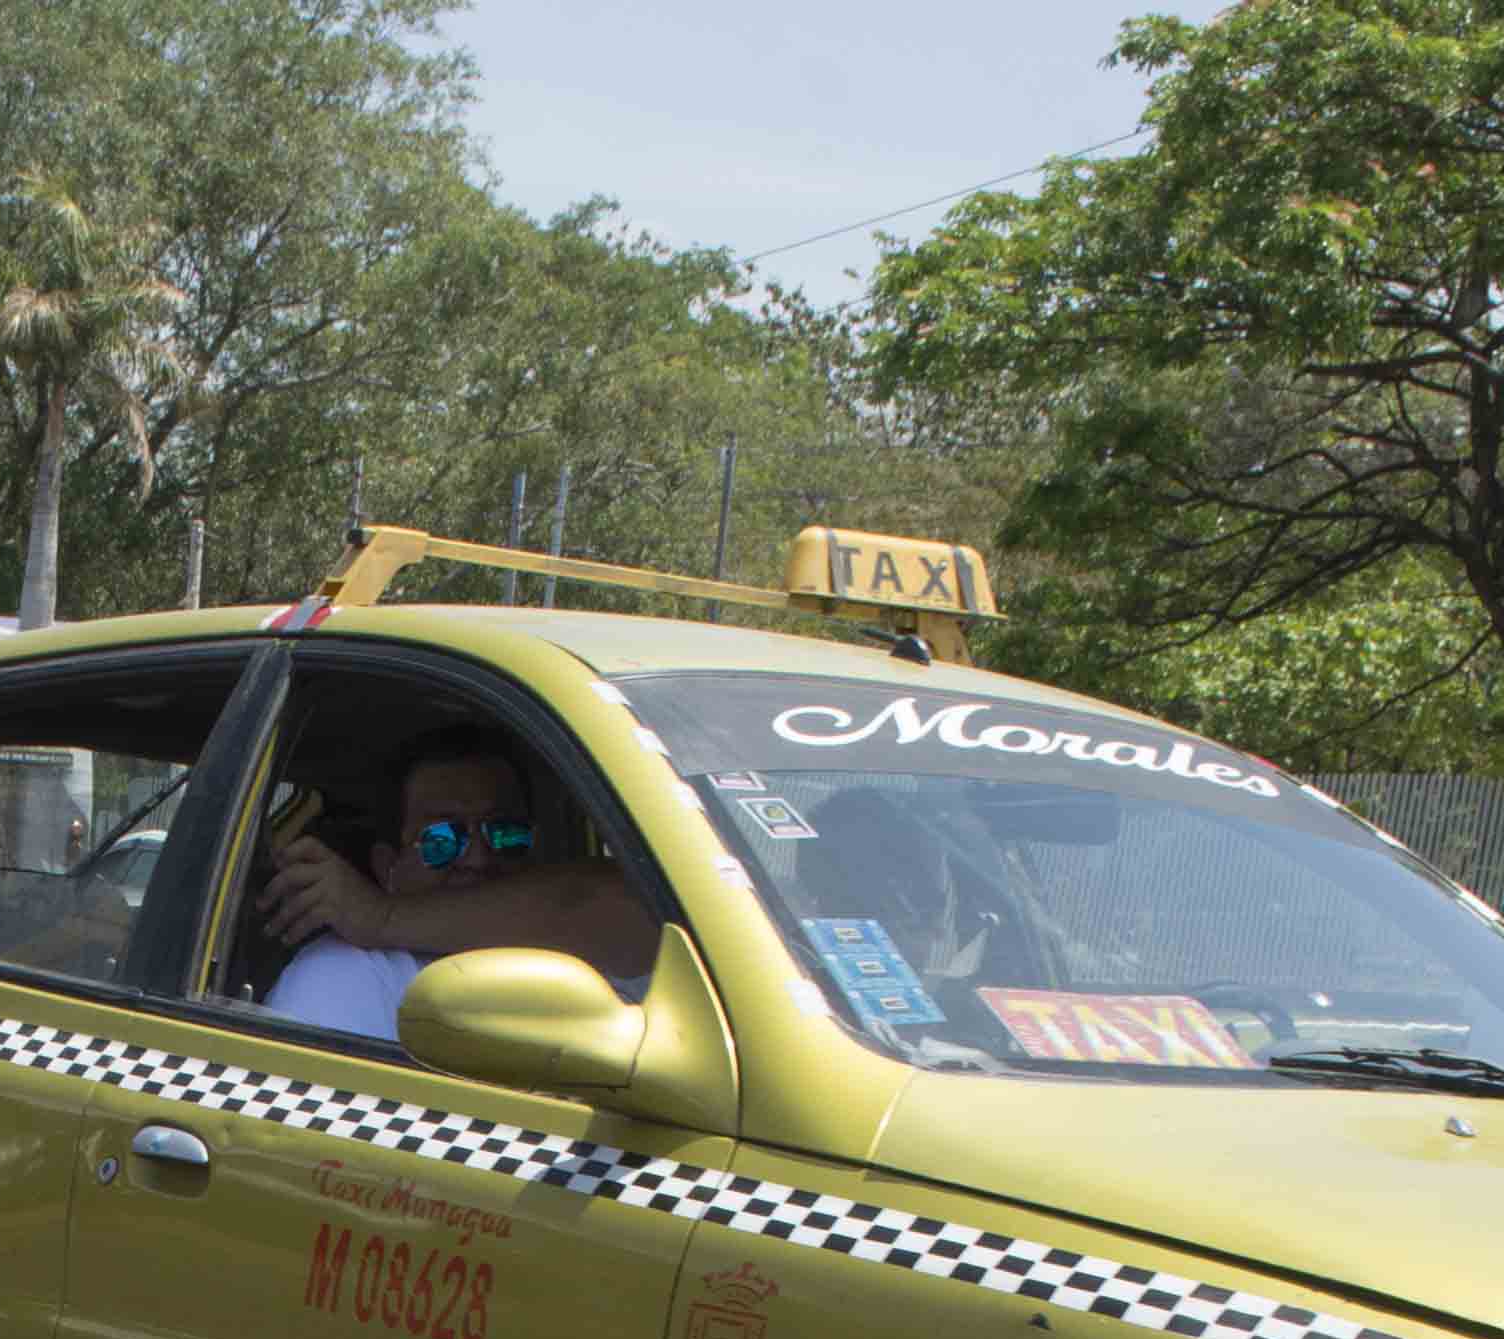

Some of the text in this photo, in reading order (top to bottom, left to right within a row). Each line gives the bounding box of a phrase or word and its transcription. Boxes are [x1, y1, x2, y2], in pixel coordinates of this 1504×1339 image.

[771, 697, 1281, 798] Morales
[1002, 999, 1250, 1069] TAXI
[312, 1158, 513, 1248] Taxi Managua
[303, 1220, 353, 1314] M
